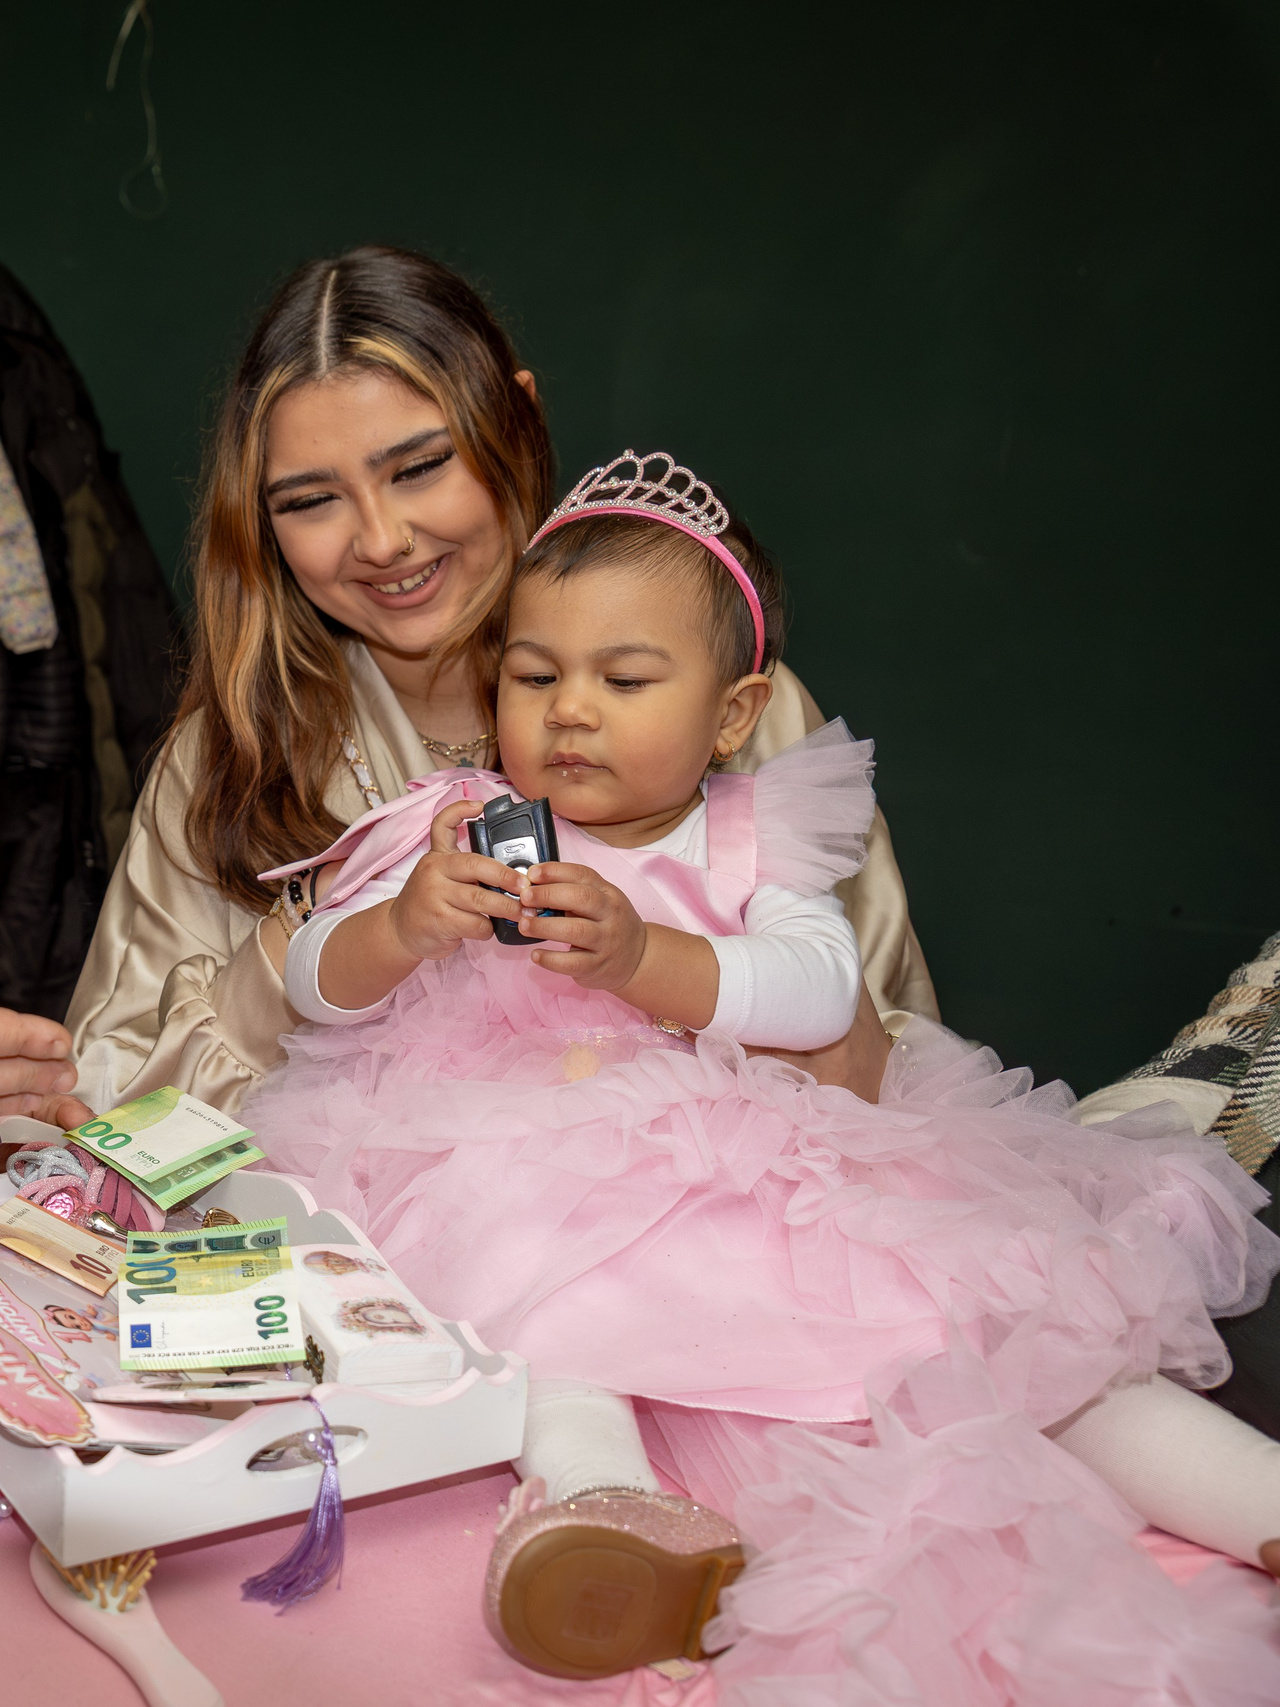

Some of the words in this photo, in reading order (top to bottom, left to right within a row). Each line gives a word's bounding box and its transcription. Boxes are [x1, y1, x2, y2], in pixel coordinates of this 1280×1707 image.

[74, 1117, 133, 1150] 00
[137, 1150, 161, 1165] EURO
[70, 1253, 113, 1280] 10
[253, 1295, 289, 1340] 100
